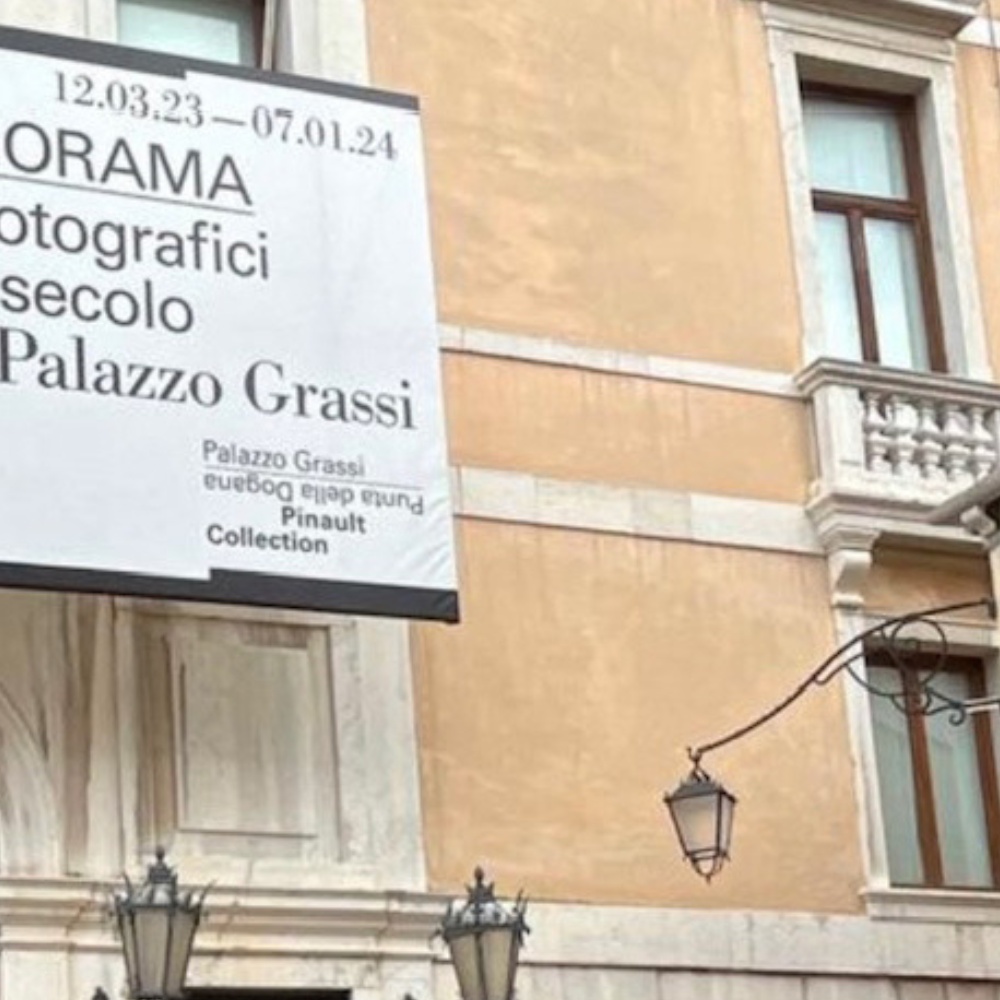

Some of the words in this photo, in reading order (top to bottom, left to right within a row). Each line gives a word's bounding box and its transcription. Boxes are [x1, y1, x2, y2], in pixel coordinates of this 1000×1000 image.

[0, 274, 195, 335] secolo
[243, 359, 415, 430] Grassi
[202, 439, 288, 470] Palazzo
[293, 449, 366, 478] Grassi
[203, 472, 294, 502] Dogana
[301, 483, 356, 507] della
[360, 489, 425, 516] Punta
[281, 505, 367, 535] Pinault
[206, 523, 329, 555] Collection
